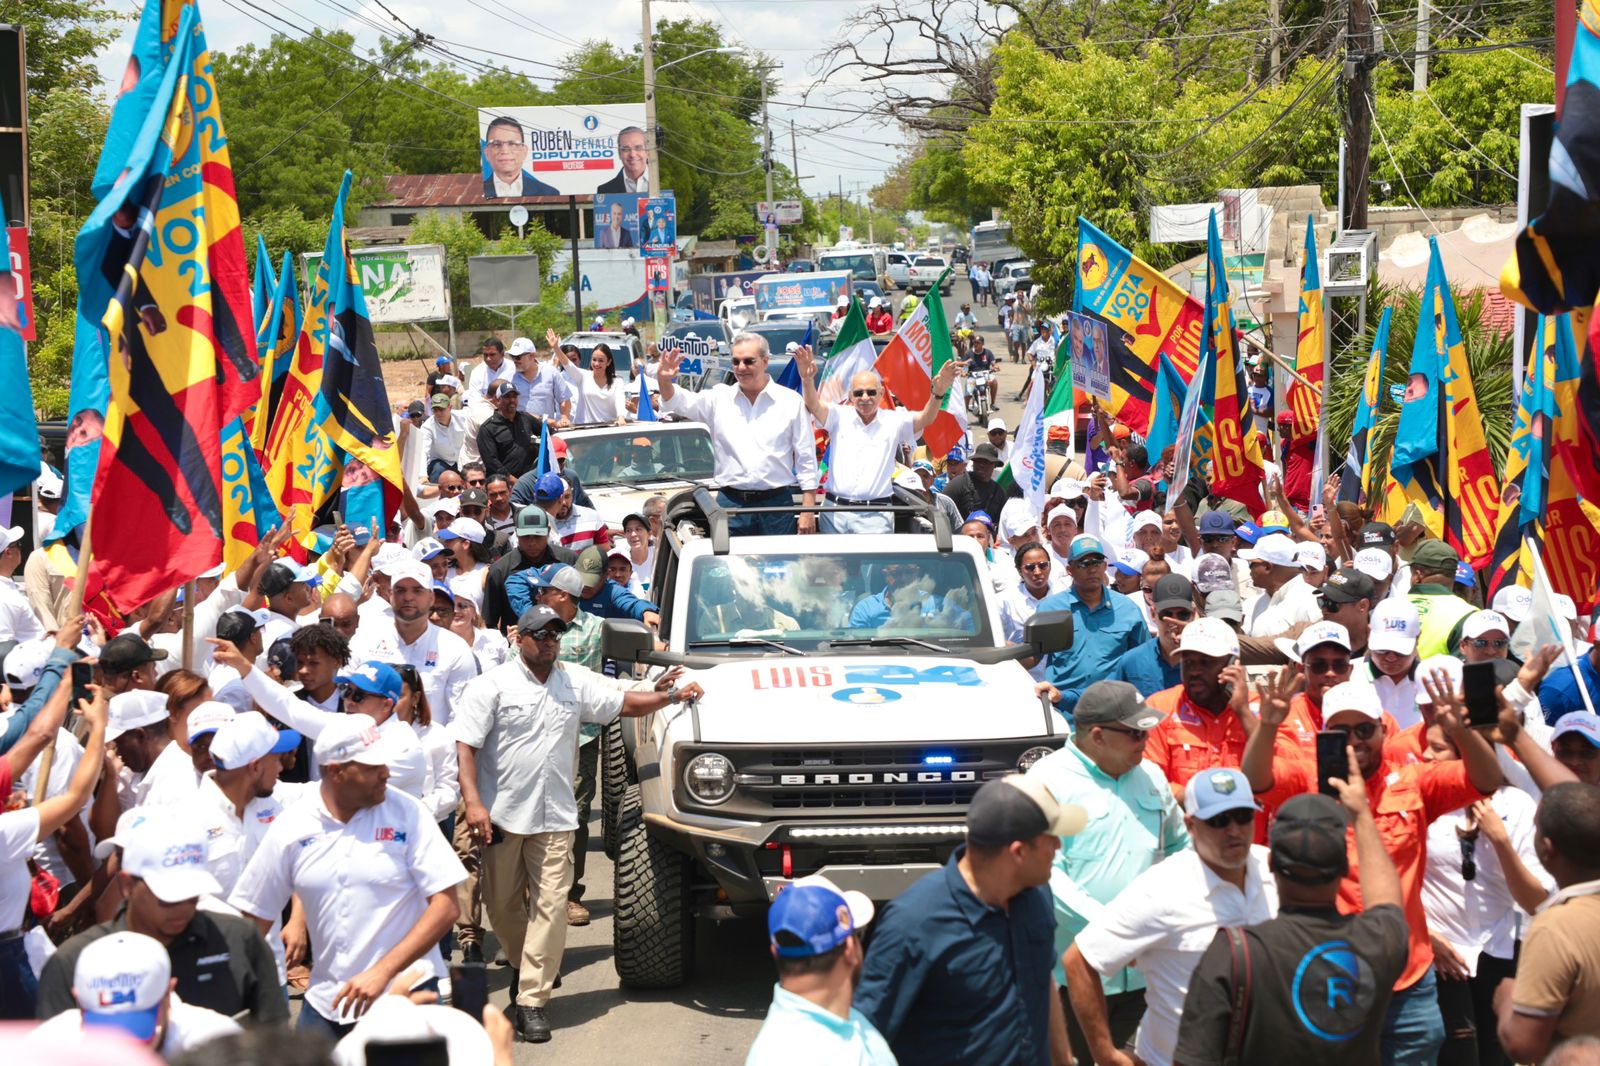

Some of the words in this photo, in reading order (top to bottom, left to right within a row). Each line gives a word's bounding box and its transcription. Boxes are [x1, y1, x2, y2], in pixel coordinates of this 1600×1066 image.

[531, 126, 572, 151] RUBÉN
[532, 149, 614, 160] DIPUTADO
[1107, 273, 1144, 318] VOTA
[1170, 324, 1184, 345] POR
[751, 666, 833, 689] LUIS
[843, 664, 988, 687] 24
[781, 771, 975, 785] BRONCO
